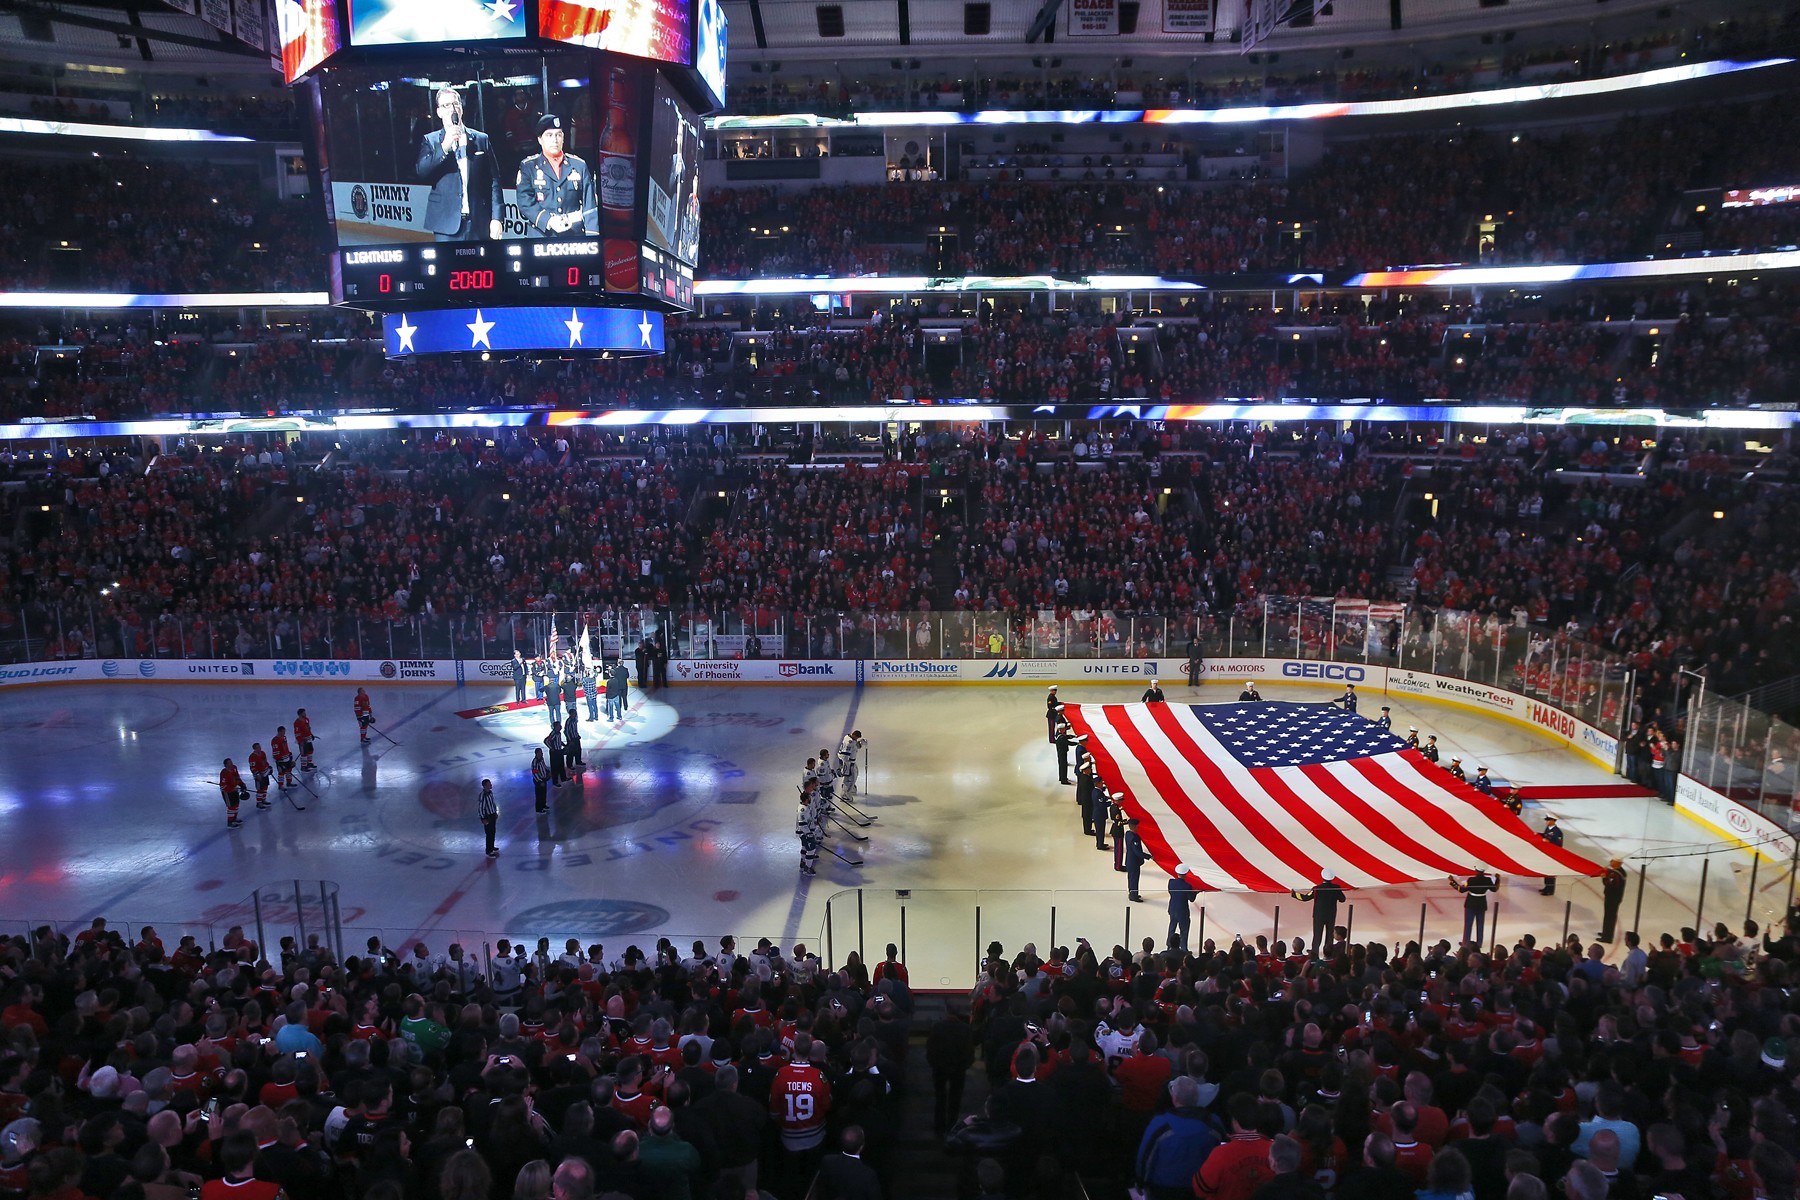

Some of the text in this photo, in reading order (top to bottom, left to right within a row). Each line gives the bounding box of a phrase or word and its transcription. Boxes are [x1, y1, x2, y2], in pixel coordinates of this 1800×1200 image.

[370, 184, 410, 202] JIMMY
[372, 204, 413, 222] JOHN'S
[455, 248, 476, 256] PERIOD
[533, 242, 599, 257] BLACKHAWKS
[345, 250, 403, 264] LIGHTNING
[606, 255, 637, 269] Budweiser
[449, 270, 494, 290] 20:00
[518, 278, 530, 286] TOL
[568, 267, 579, 286] 0
[379, 274, 391, 293] 0
[414, 282, 425, 290] TOL
[31, 666, 77, 677] LIGHT
[188, 665, 239, 673] UNITED
[399, 661, 434, 669] JIMMY
[479, 661, 513, 673] comca
[694, 662, 739, 672] University
[882, 662, 958, 672] NorthShore
[1084, 665, 1140, 673] UNITED
[1210, 664, 1226, 672] KIA
[1227, 664, 1265, 673] MOTORS
[400, 670, 435, 679] JOHN'S
[694, 671, 741, 679] of Phoenix
[1282, 662, 1365, 682] GEICO
[1389, 676, 1431, 690] NHL.COM/GCL
[1436, 680, 1514, 706] WeatherTech
[1533, 703, 1576, 739] HARIBO
[1730, 810, 1748, 831] KIA
[787, 1081, 813, 1092] TOEWS
[784, 1093, 814, 1122] 19
